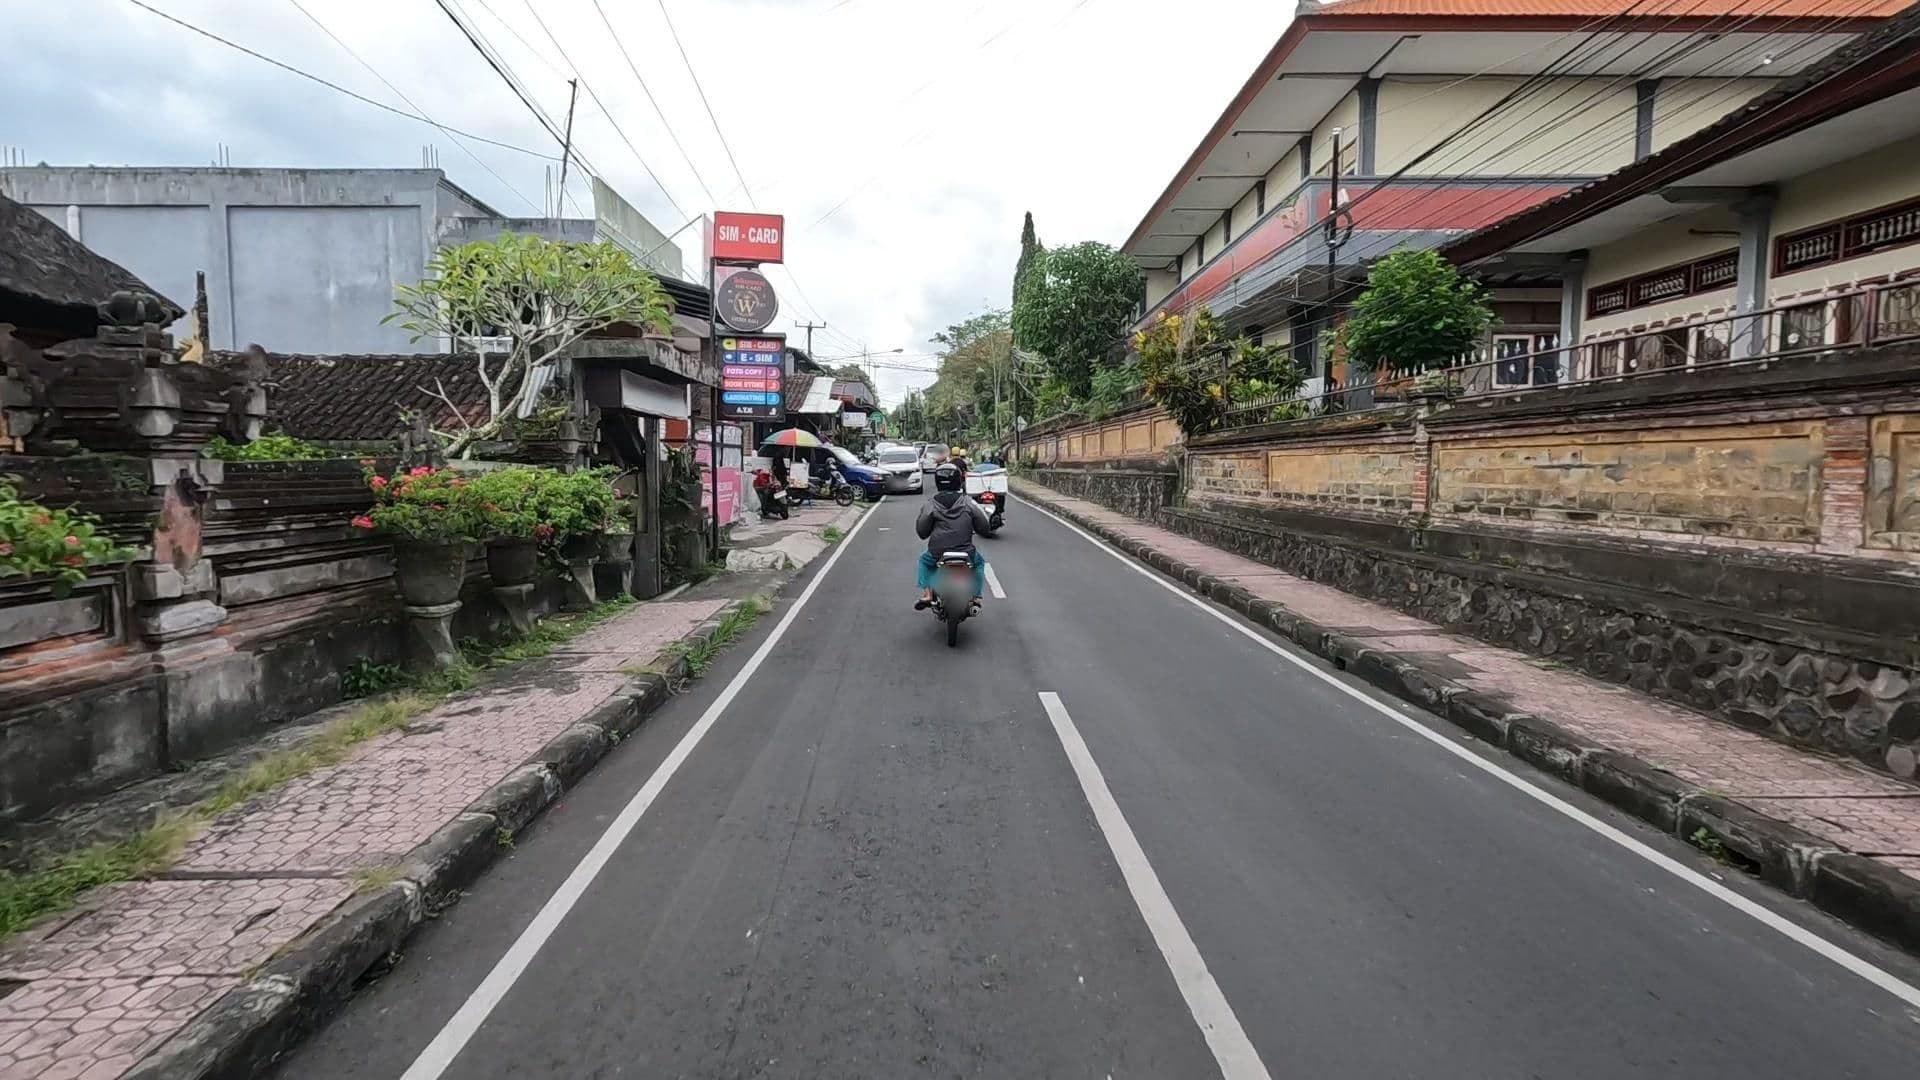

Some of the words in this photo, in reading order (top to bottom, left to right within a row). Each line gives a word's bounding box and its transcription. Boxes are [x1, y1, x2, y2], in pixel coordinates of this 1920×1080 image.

[719, 226, 739, 241] SIM
[748, 227, 778, 244] CARD
[759, 341, 777, 349] CARD
[755, 353, 773, 363] SIM
